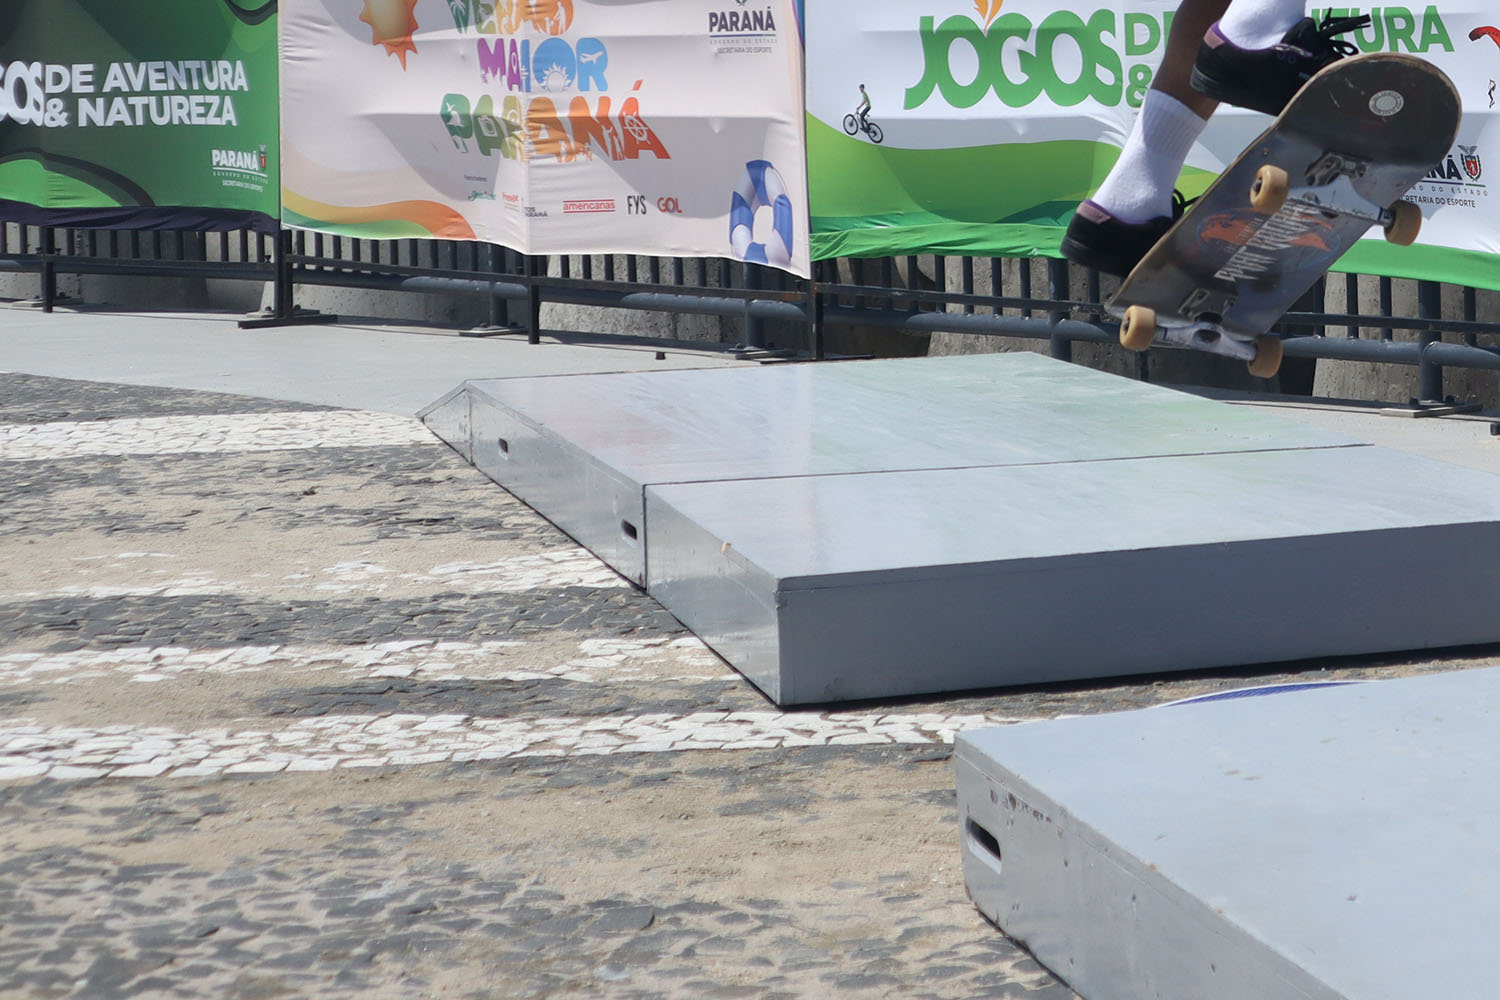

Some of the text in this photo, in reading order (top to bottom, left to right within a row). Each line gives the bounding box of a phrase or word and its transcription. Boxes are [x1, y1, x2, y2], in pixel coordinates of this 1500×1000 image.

[709, 6, 776, 33] PARANÁ
[477, 37, 609, 93] MAIOR
[904, 9, 1123, 110] JOGOS
[0, 60, 248, 127] OS DE AVENTURA
[44, 95, 237, 127] & NATUREZA
[440, 79, 672, 163] PARANÁ
[212, 149, 259, 171] PARANÁ
[627, 195, 647, 215] FYS
[657, 196, 683, 214] GOL
[1435, 196, 1446, 205] DO
[1447, 198, 1476, 208] ESPORTE
[1451, 187, 1488, 197] ESTADO
